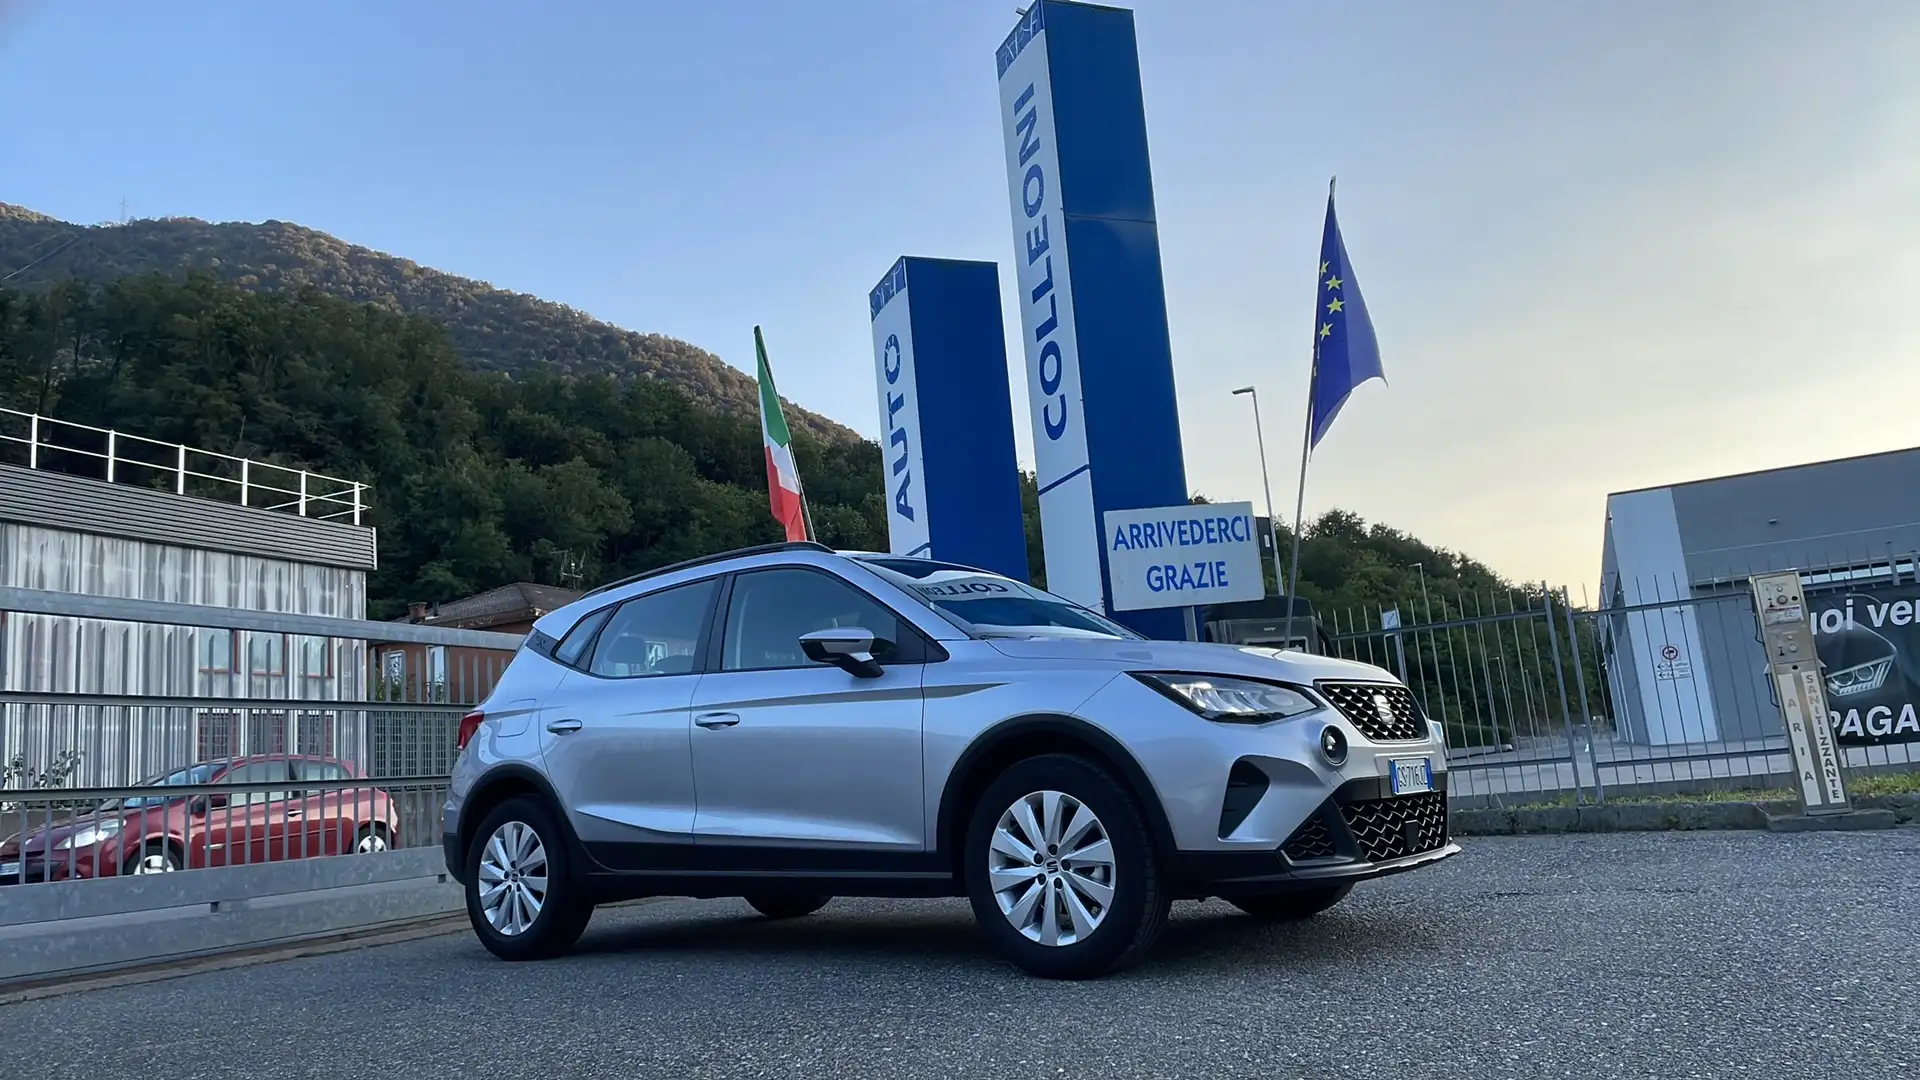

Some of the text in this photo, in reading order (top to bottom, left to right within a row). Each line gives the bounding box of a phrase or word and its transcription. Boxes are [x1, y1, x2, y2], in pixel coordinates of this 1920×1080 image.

[1014, 82, 1067, 441] COLLEONI
[884, 333, 915, 523] AUTO
[1113, 516, 1251, 551] ARRIVEDERCI
[1146, 561, 1229, 592] GRAZIE
[1867, 600, 1920, 628] ve
[1787, 698, 1814, 781] ARIA
[1806, 673, 1840, 799] SANITIZZANTE
